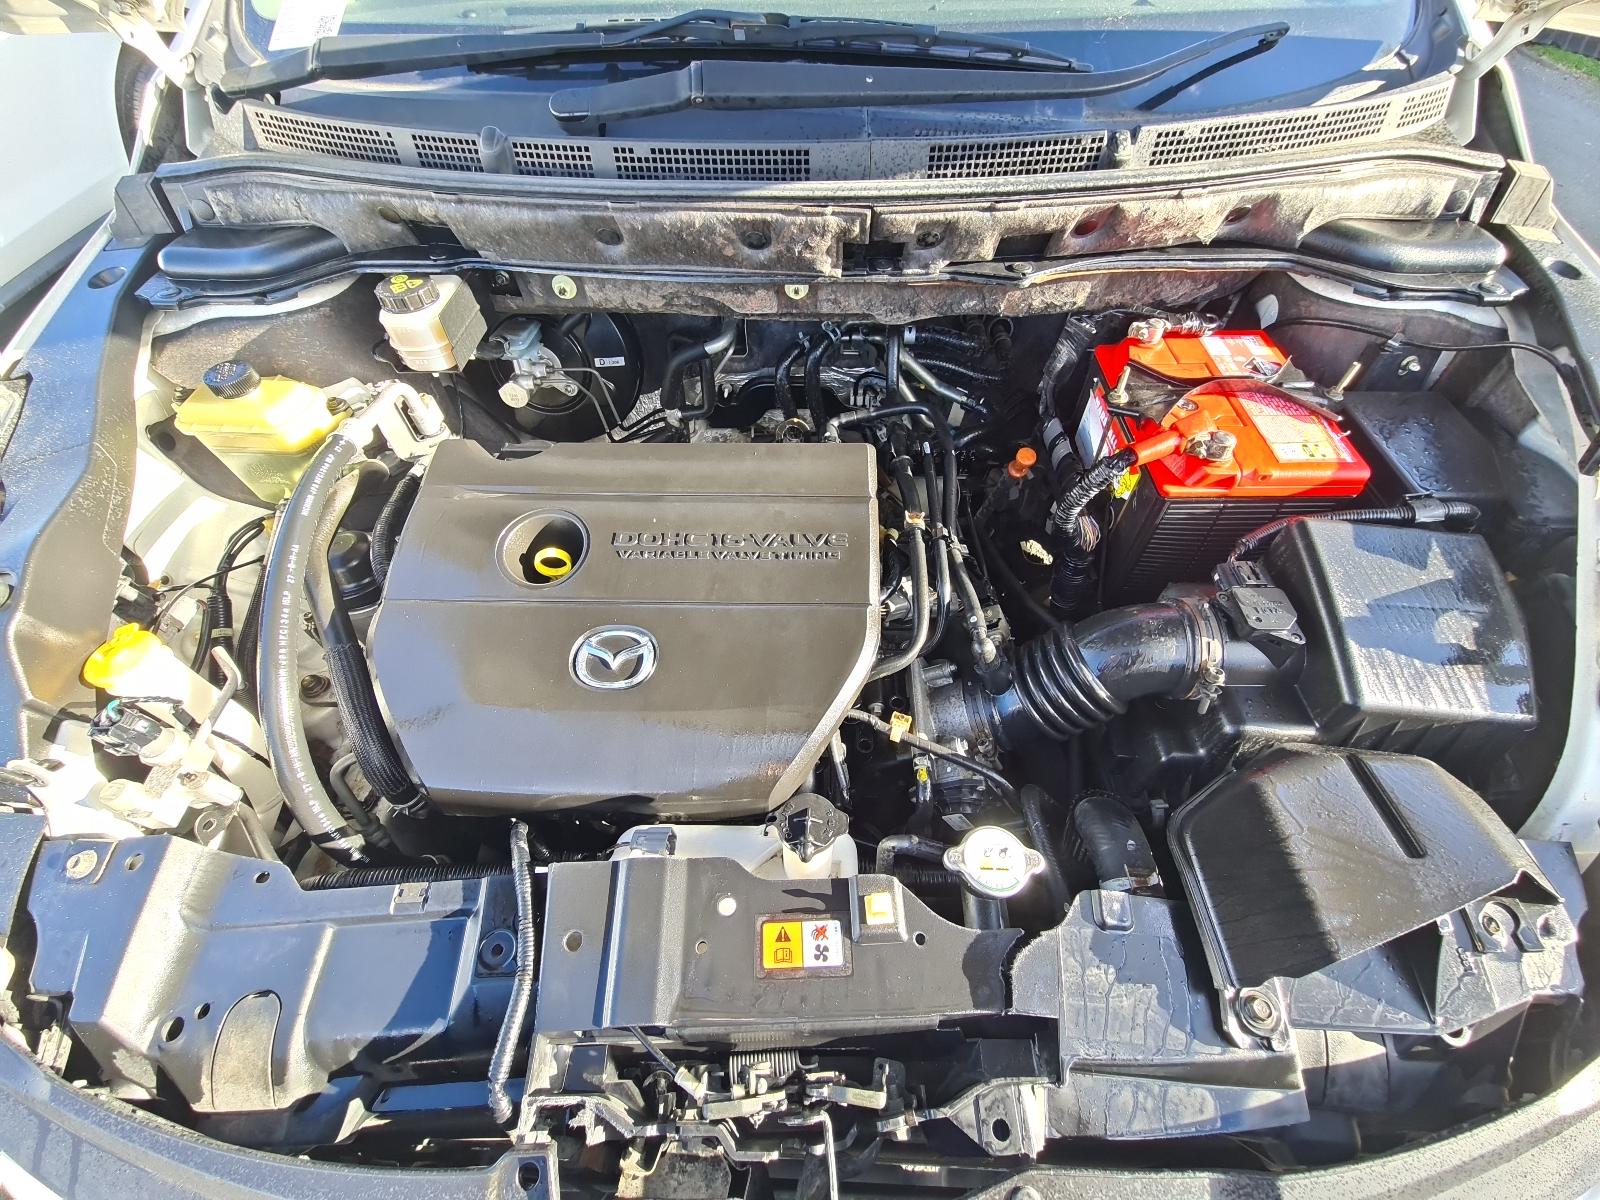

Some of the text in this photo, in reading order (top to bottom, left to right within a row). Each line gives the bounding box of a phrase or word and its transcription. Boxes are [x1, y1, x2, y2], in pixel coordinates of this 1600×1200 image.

[611, 532, 709, 547] DOHC
[616, 550, 841, 560] VARIABLE VALVE TIMING
